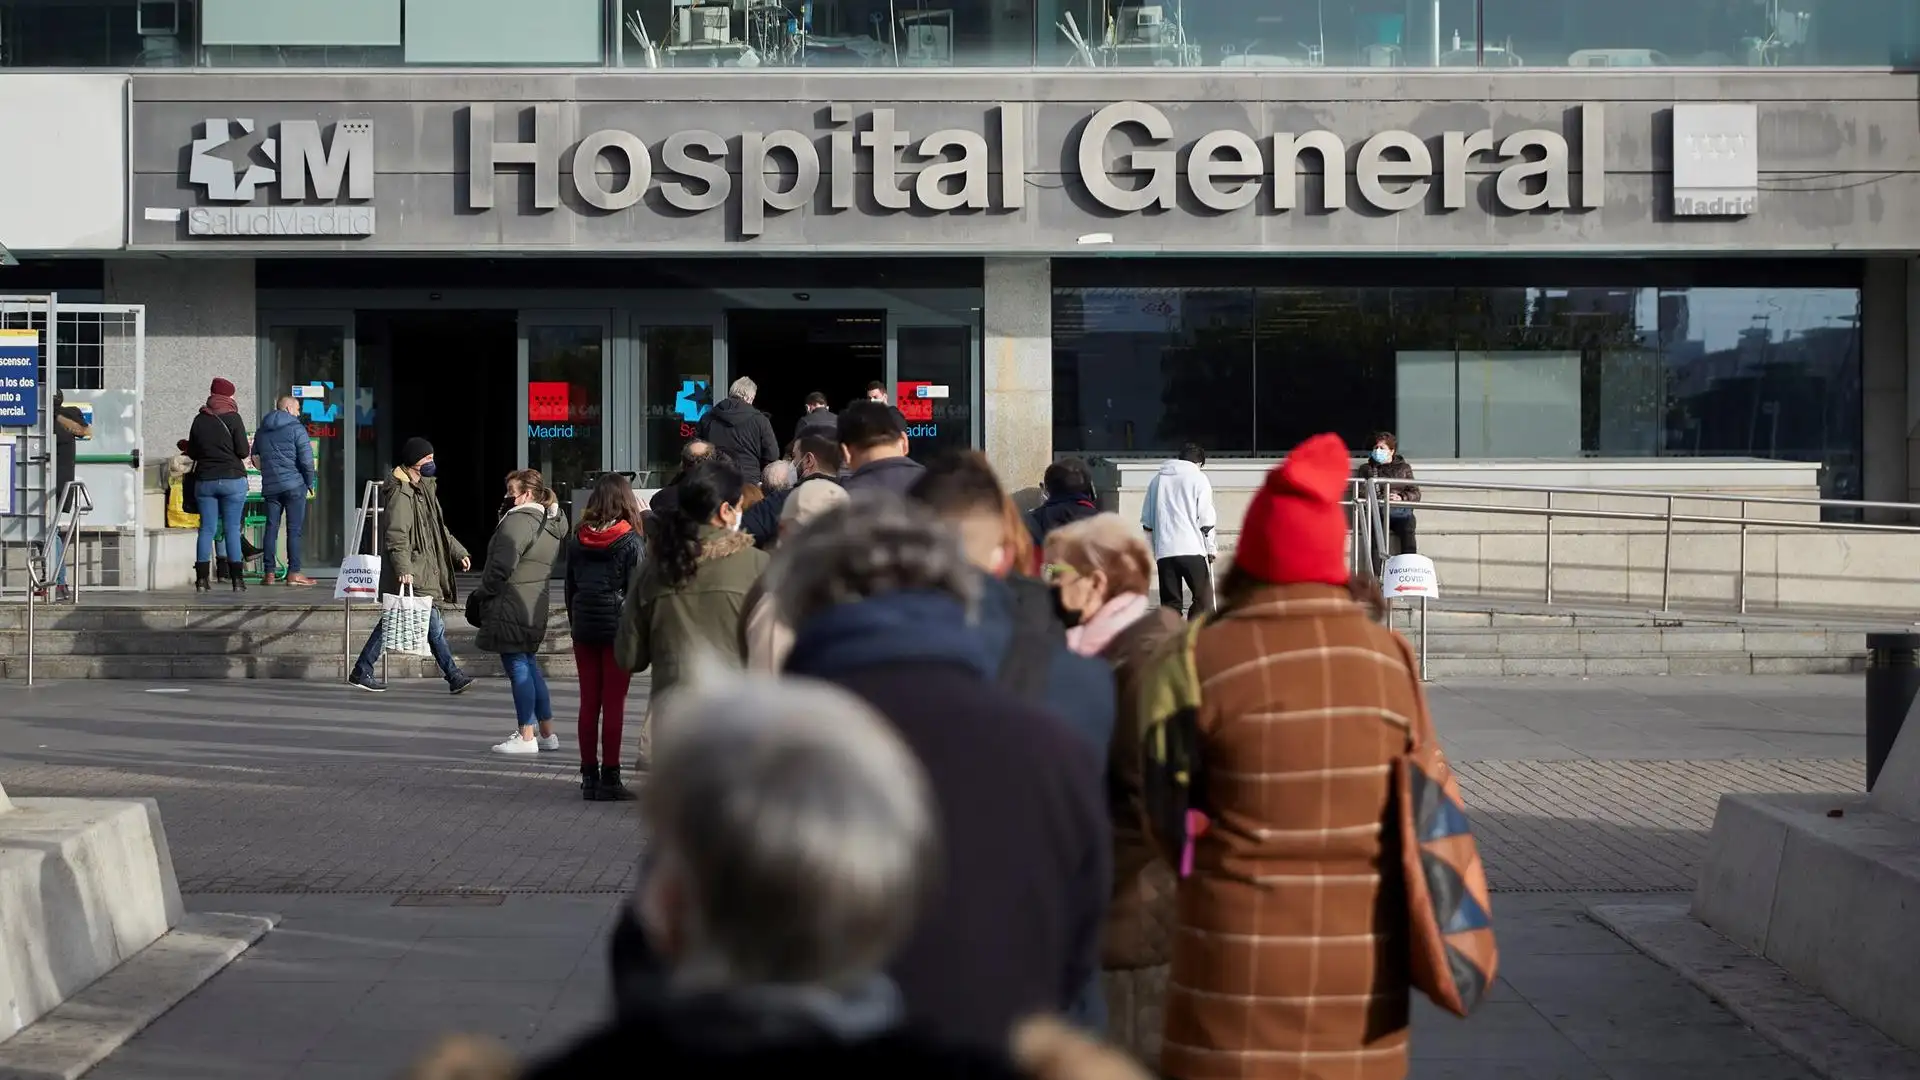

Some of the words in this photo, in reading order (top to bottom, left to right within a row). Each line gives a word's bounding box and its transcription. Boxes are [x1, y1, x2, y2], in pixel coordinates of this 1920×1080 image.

[470, 102, 1025, 235] Hospital
[1079, 101, 1604, 211] General
[1674, 196, 1758, 214] Madrid
[190, 207, 373, 235] SaludMadrid
[6, 377, 18, 387] los
[19, 377, 35, 387] dos
[15, 393, 21, 401] a
[528, 424, 574, 438] Madrid
[906, 424, 937, 437] adrid
[348, 576, 373, 584] COVID
[1399, 575, 1424, 583] COVID
